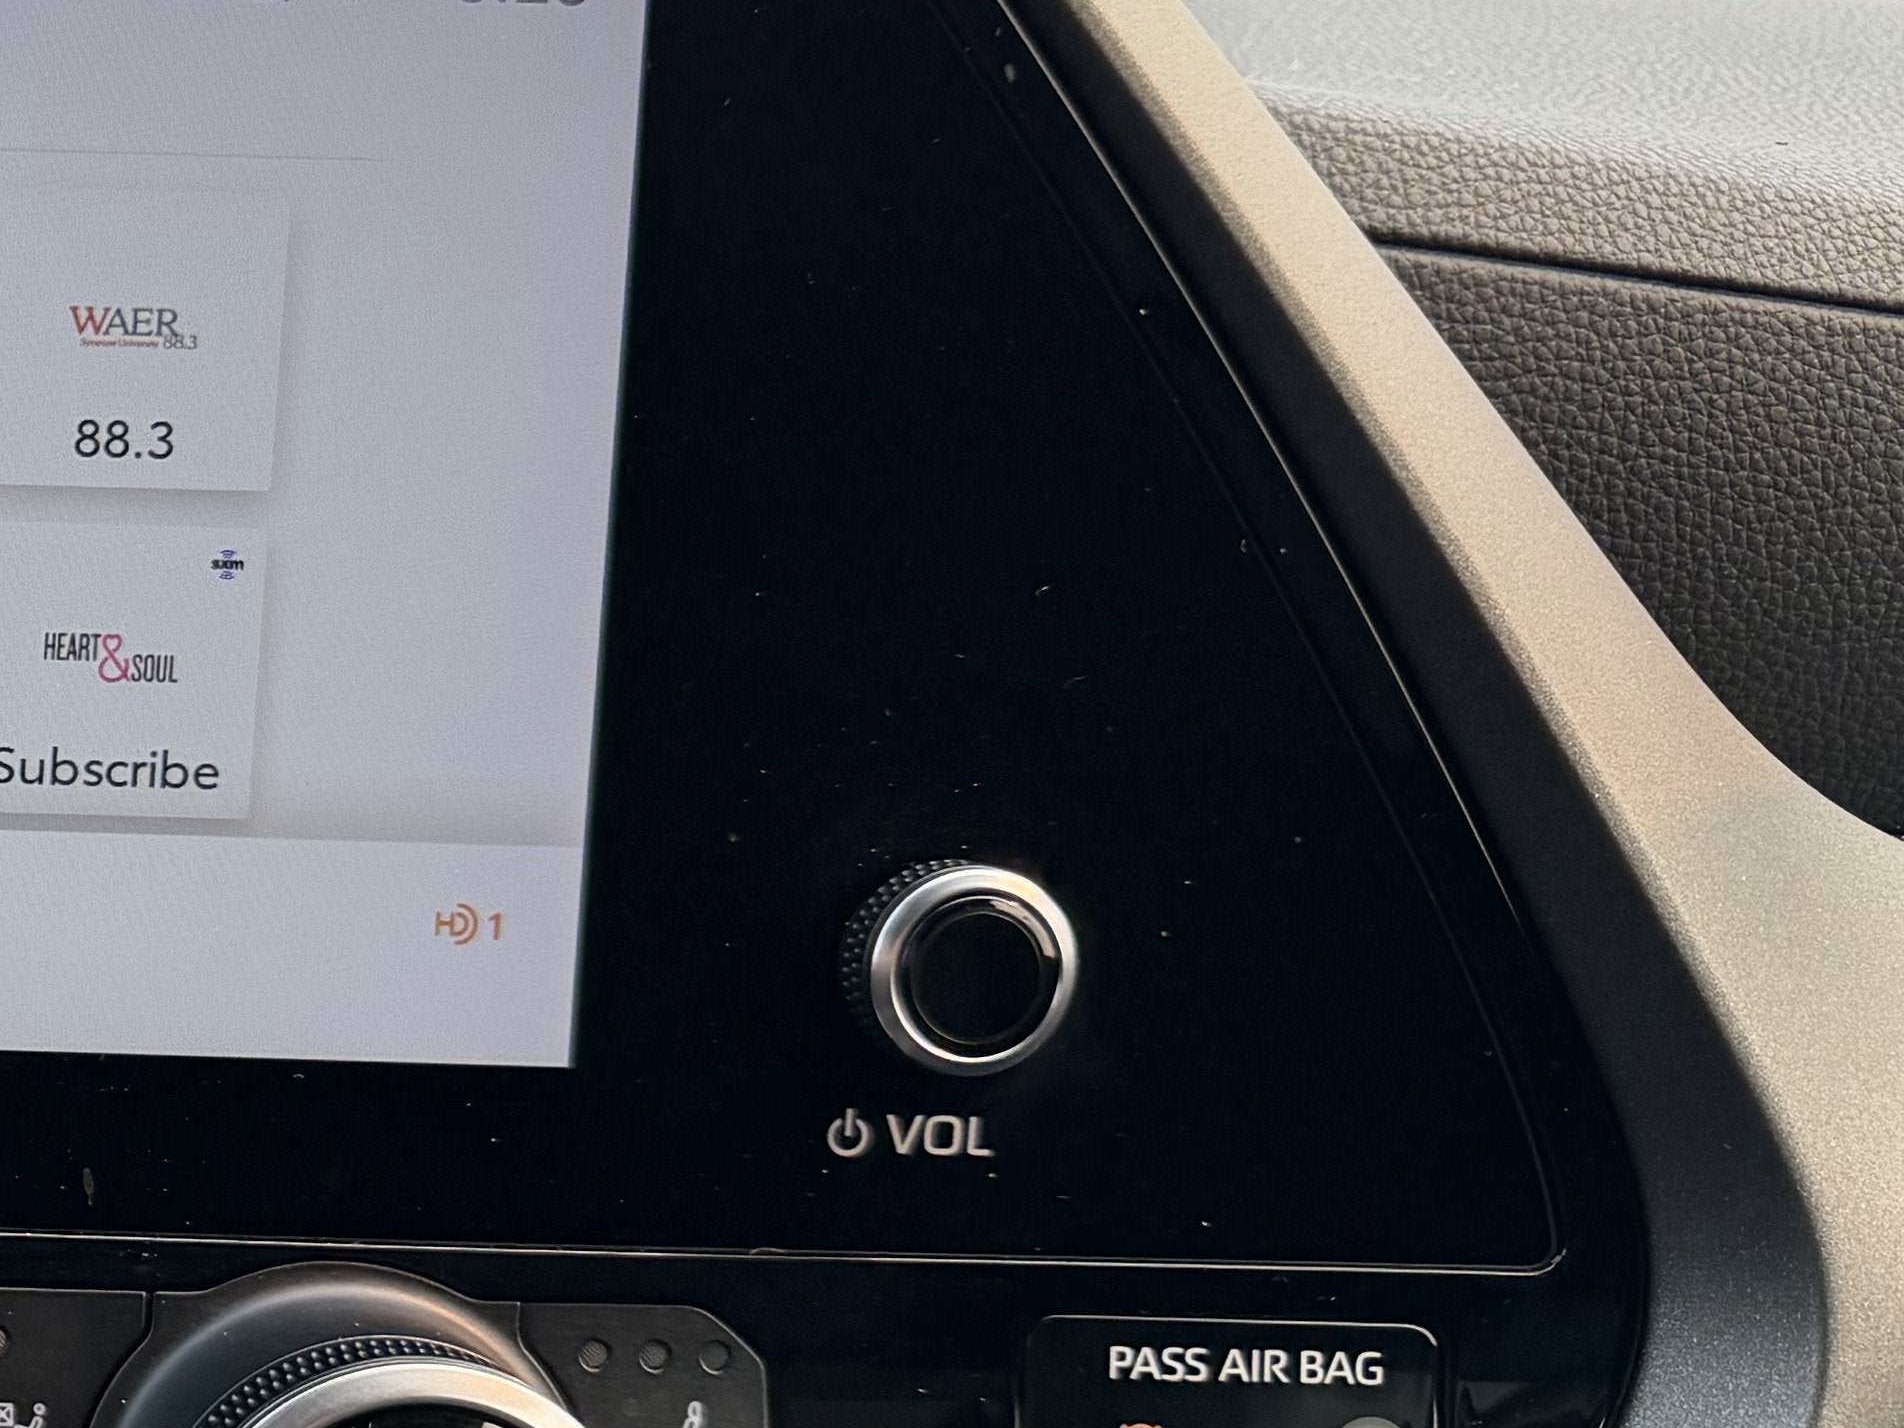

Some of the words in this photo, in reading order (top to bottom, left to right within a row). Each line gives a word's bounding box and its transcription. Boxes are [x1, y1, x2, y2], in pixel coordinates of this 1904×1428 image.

[69, 305, 179, 337] WAER
[74, 419, 176, 462] 88.3
[886, 1113, 995, 1159] VOL
[1108, 1345, 1211, 1382] PASS
[1218, 1349, 1291, 1384] AIR
[1300, 1350, 1385, 1386] BAG
